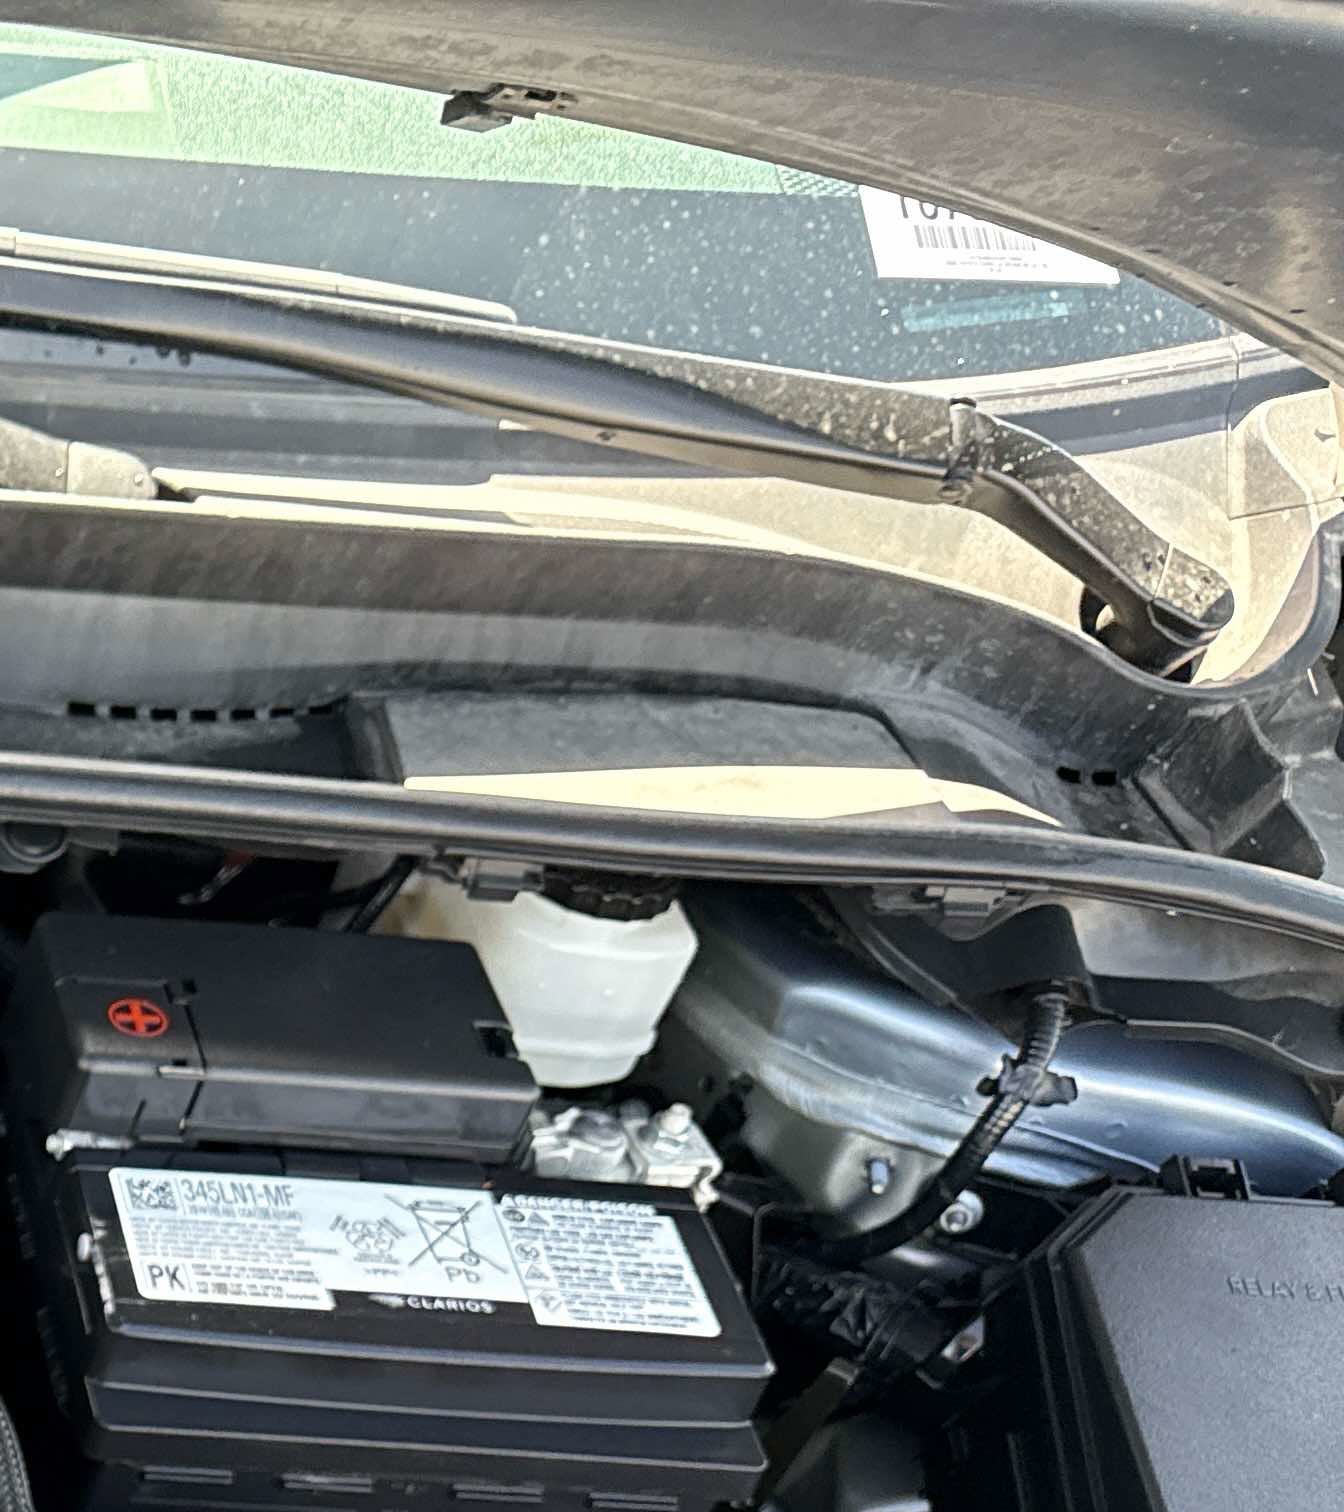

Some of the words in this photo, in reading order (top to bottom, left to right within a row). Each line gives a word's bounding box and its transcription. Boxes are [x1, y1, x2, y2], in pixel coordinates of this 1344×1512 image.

[182, 1178, 294, 1206] 345LN1-MF
[148, 1263, 186, 1291] PK
[444, 1265, 482, 1284] Pb
[407, 1296, 496, 1314] CLARIOS
